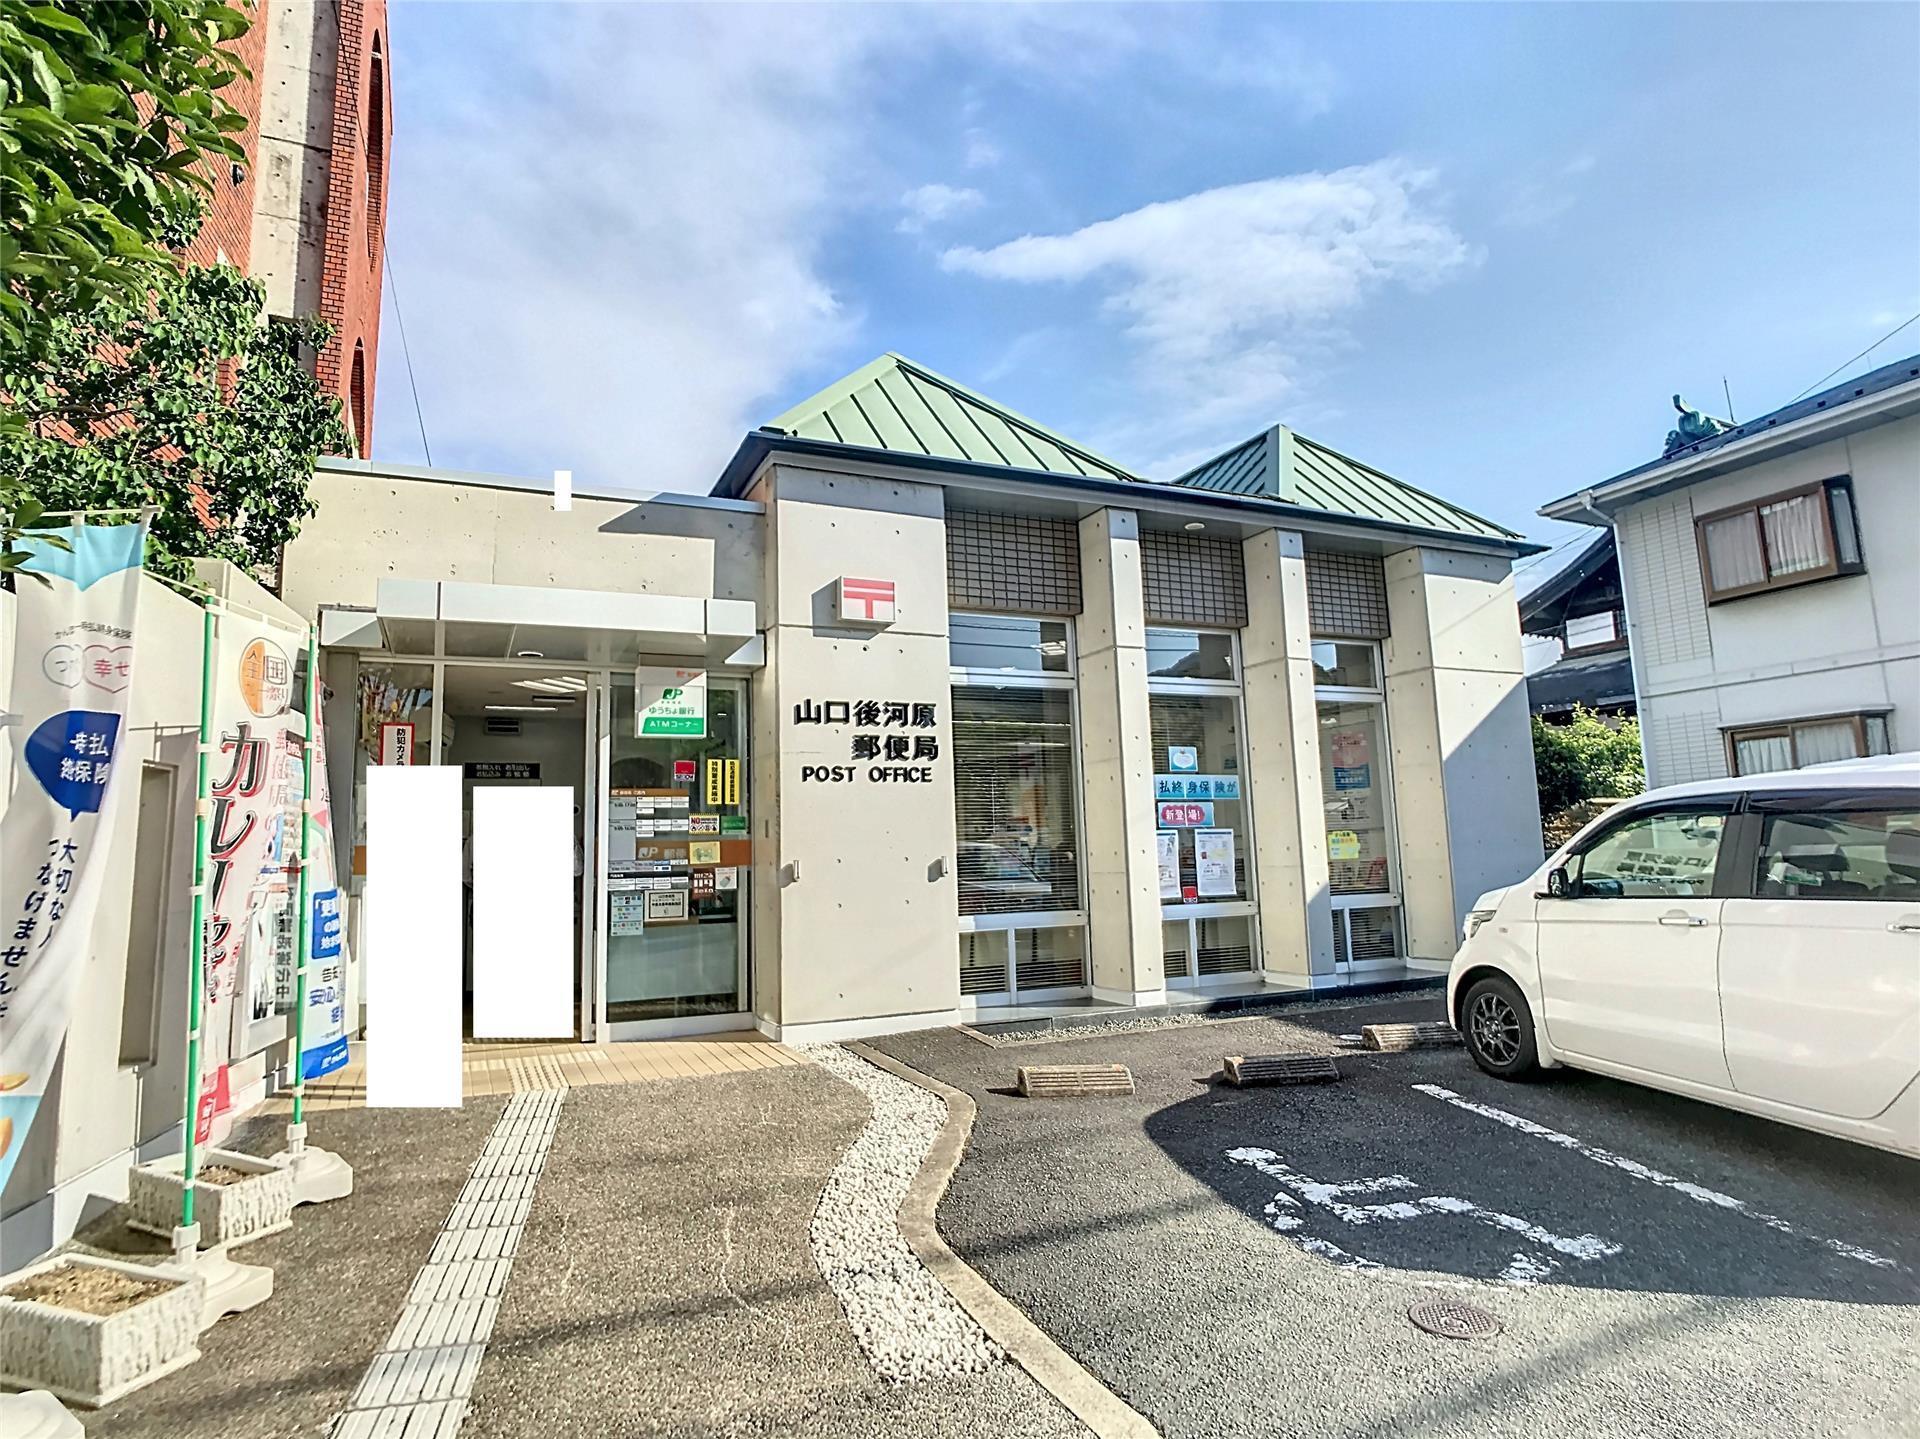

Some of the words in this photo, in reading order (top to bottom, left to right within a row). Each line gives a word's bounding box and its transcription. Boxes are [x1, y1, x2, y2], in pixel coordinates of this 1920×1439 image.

[93, 658, 130, 679] 幸せ
[648, 706, 695, 715] ゆうちょ銀行
[793, 699, 937, 728] 山口後河原
[851, 734, 939, 761] 郵便局
[801, 765, 857, 783] POST
[867, 765, 933, 783] OFFICE
[1159, 780, 1237, 793] 払終身保険が
[1166, 809, 1201, 821] 新登場!
